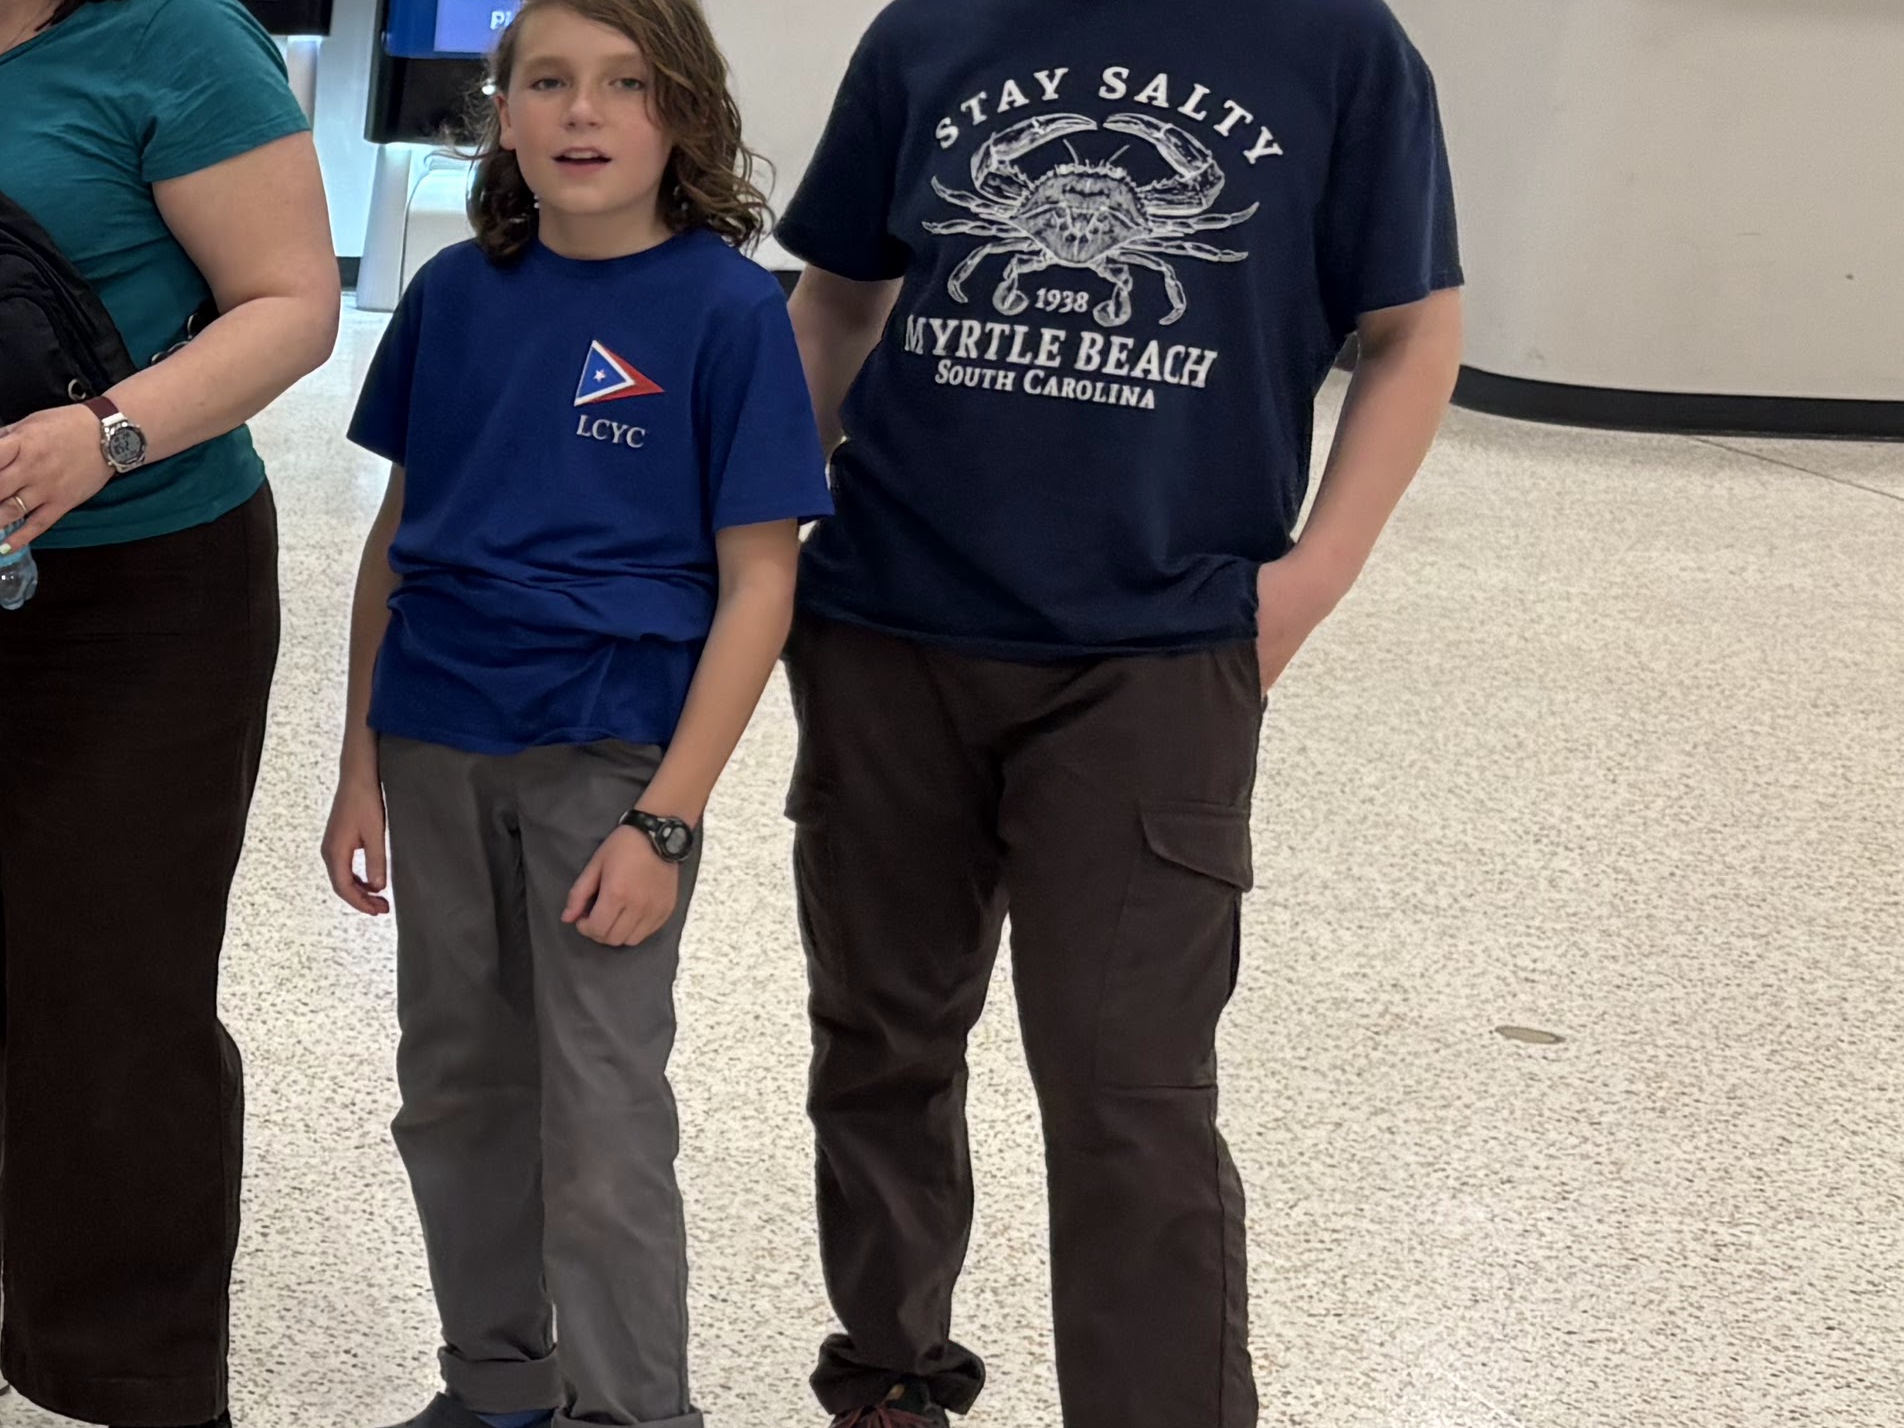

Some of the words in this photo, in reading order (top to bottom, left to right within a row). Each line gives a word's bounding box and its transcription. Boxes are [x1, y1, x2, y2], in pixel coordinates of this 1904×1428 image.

[935, 67, 1069, 150] STAY
[1098, 66, 1284, 165] SALTY
[1035, 287, 1089, 314] 1938
[904, 315, 1066, 368] MYRTLE
[1076, 331, 1218, 389] BEACH
[935, 360, 1013, 392] SOUTH
[1023, 369, 1155, 410] CAROLINA
[576, 415, 646, 448] LCYC
